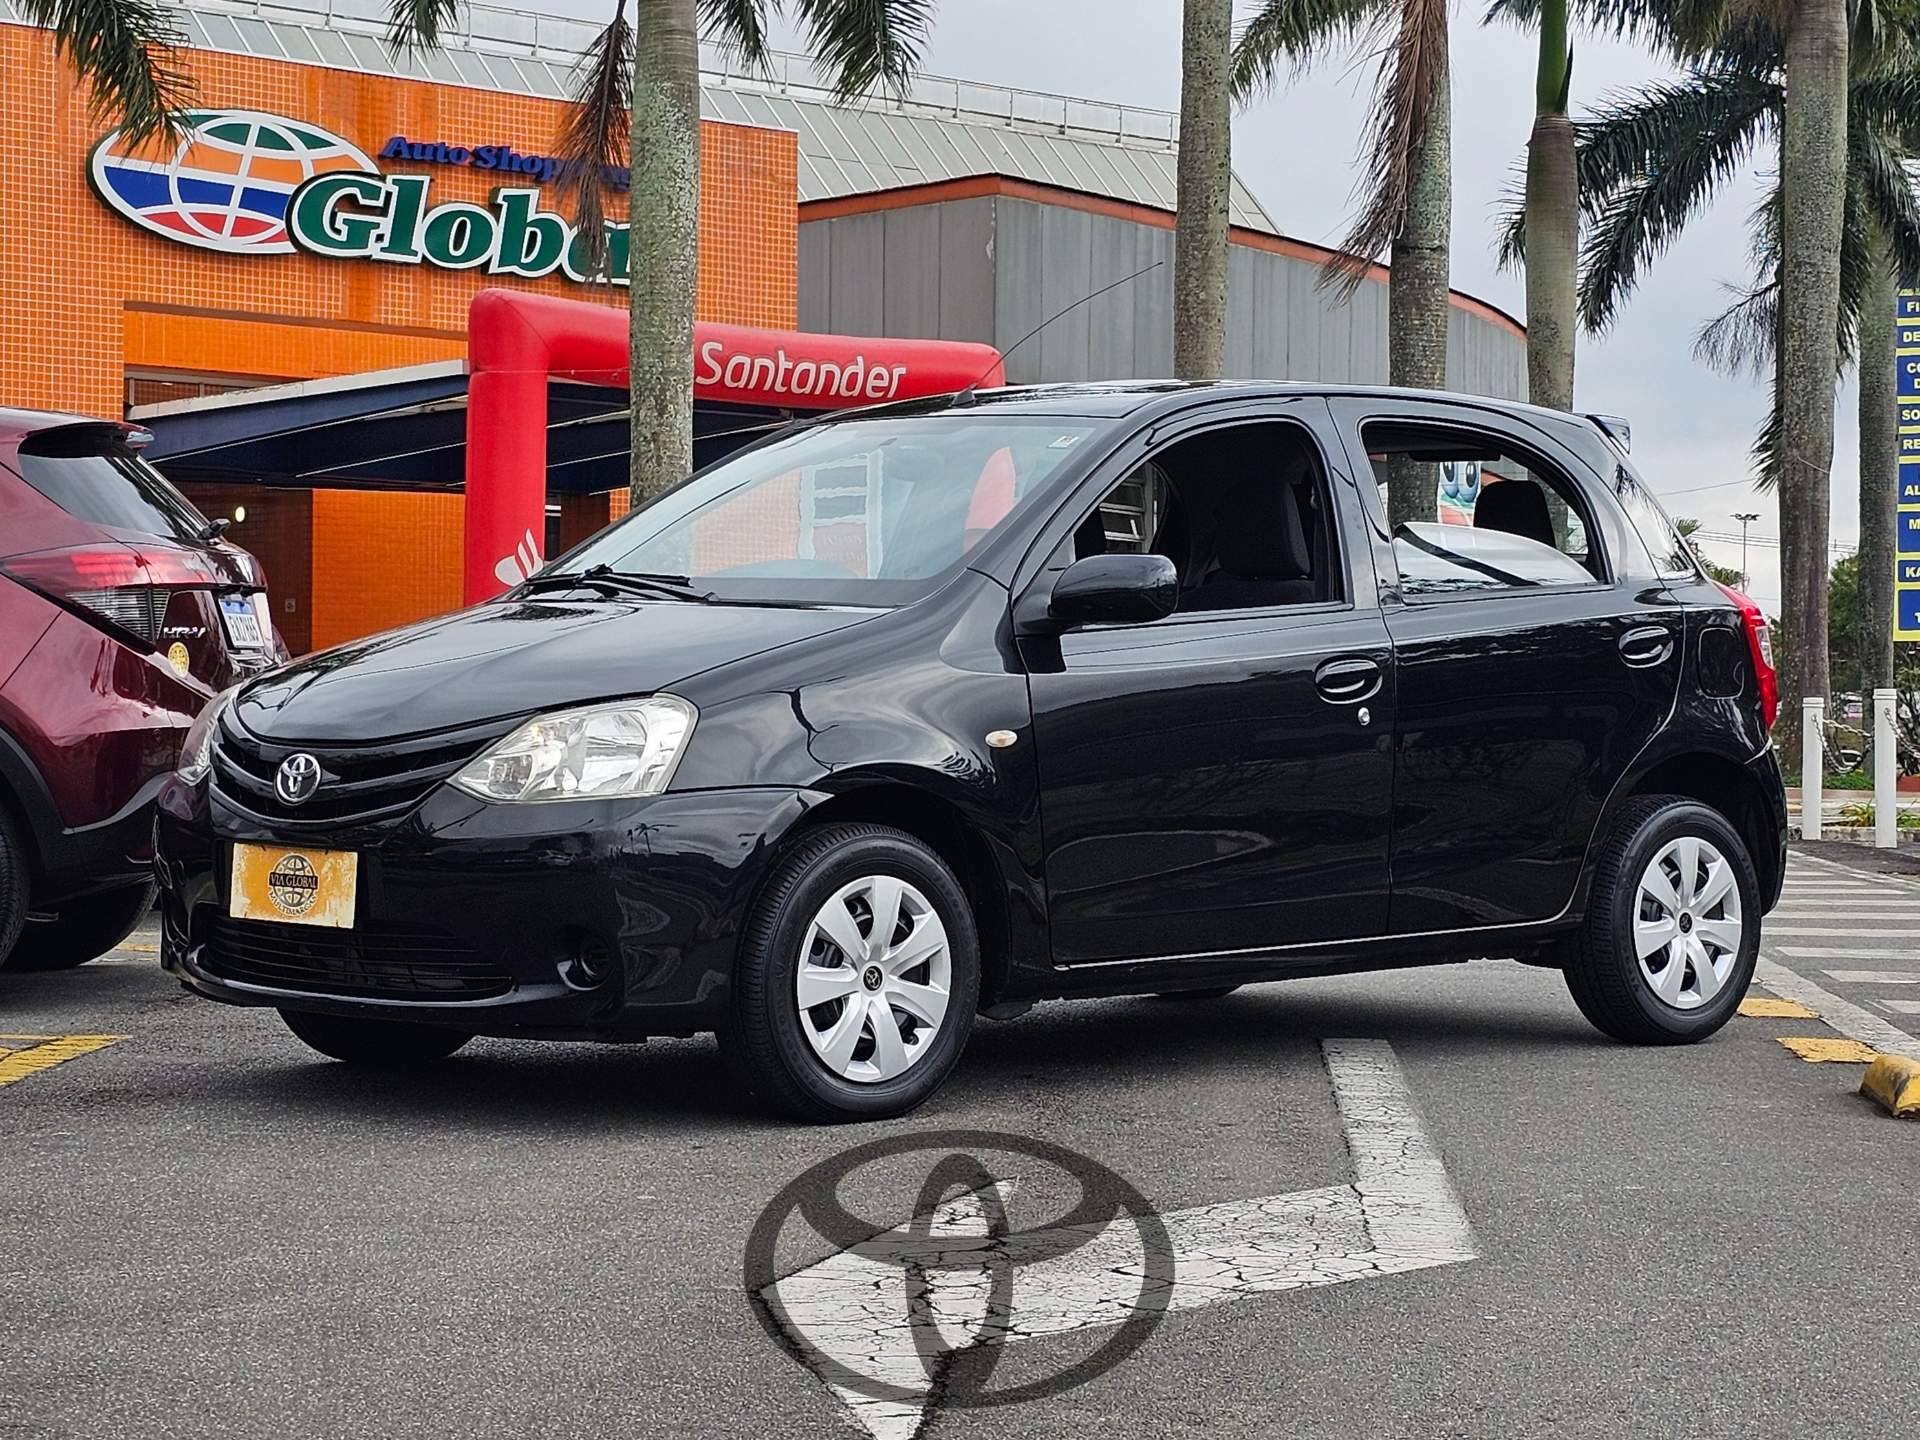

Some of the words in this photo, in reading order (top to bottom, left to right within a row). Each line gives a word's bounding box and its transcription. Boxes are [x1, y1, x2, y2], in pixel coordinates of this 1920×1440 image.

[379, 136, 470, 165] Auto
[293, 172, 631, 285] Globa
[695, 341, 906, 398] Santander
[270, 873, 285, 886] VIA
[286, 874, 317, 889] GLOBAL
